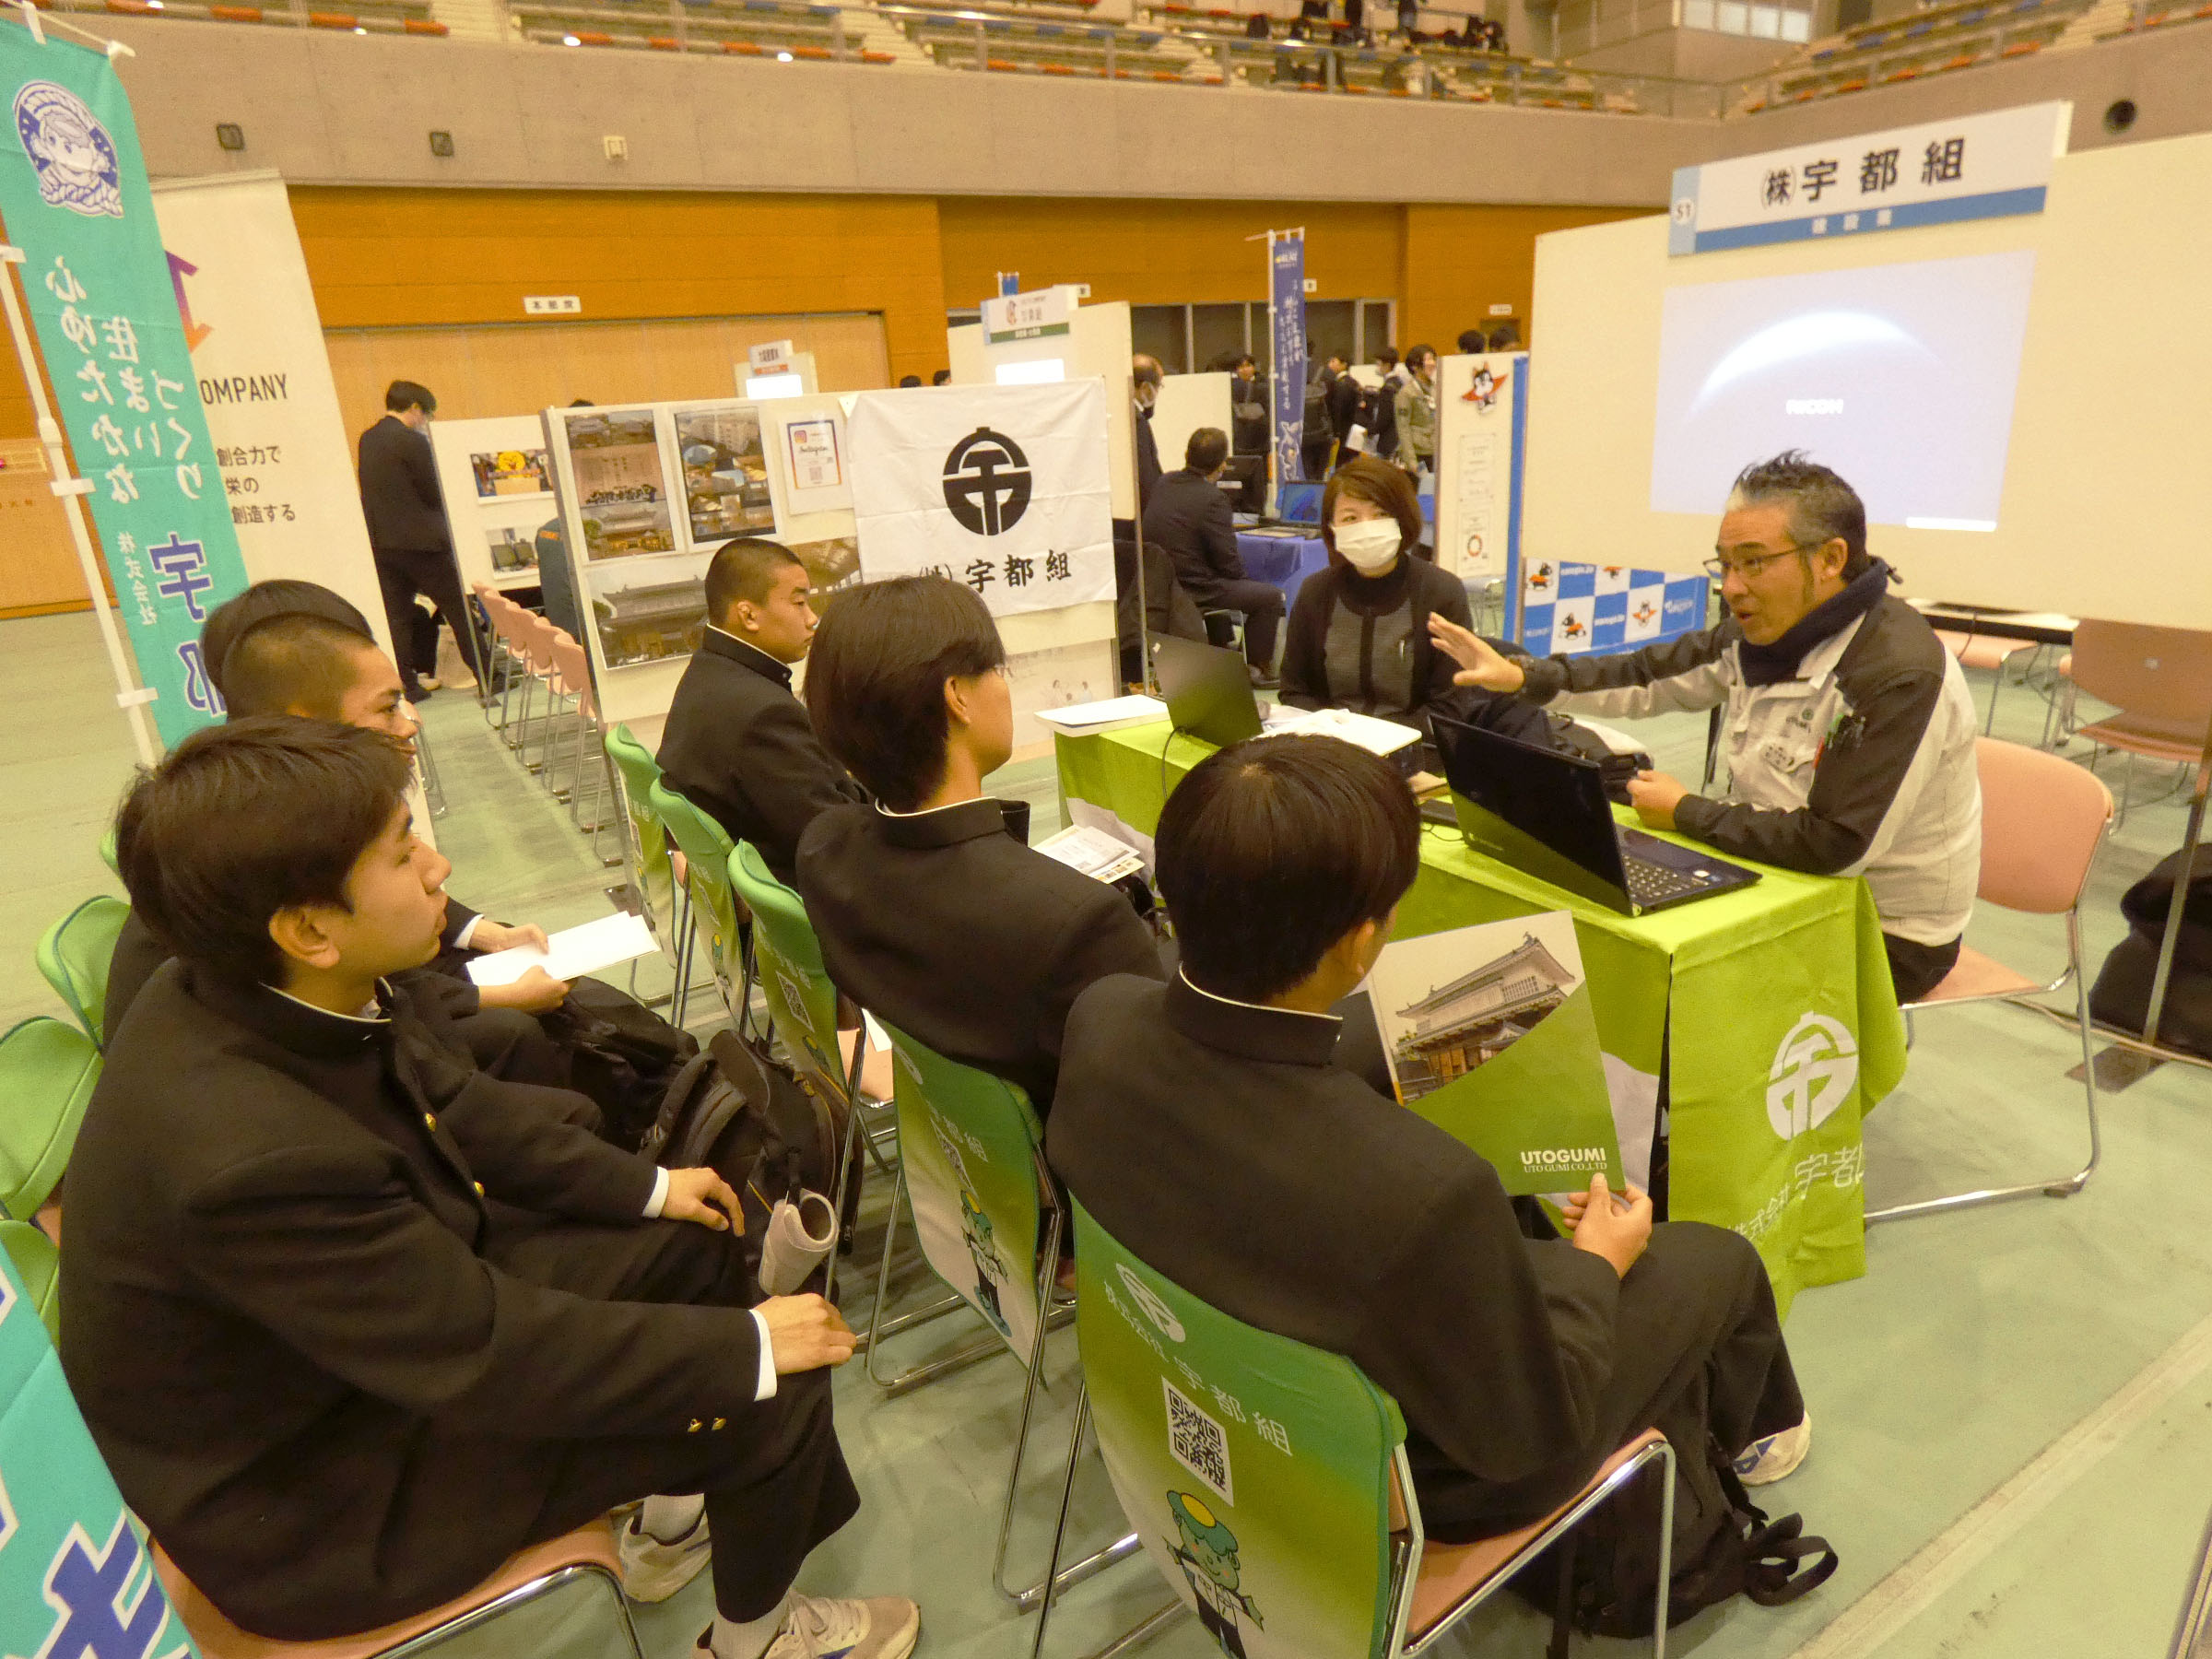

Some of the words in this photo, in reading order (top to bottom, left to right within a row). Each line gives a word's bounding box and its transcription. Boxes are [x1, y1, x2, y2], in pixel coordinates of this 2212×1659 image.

[231, 504, 296, 524] 創造する
[1520, 1147, 1606, 1165] UTOGUMI
[1172, 1356, 1293, 1457] 宇都組
